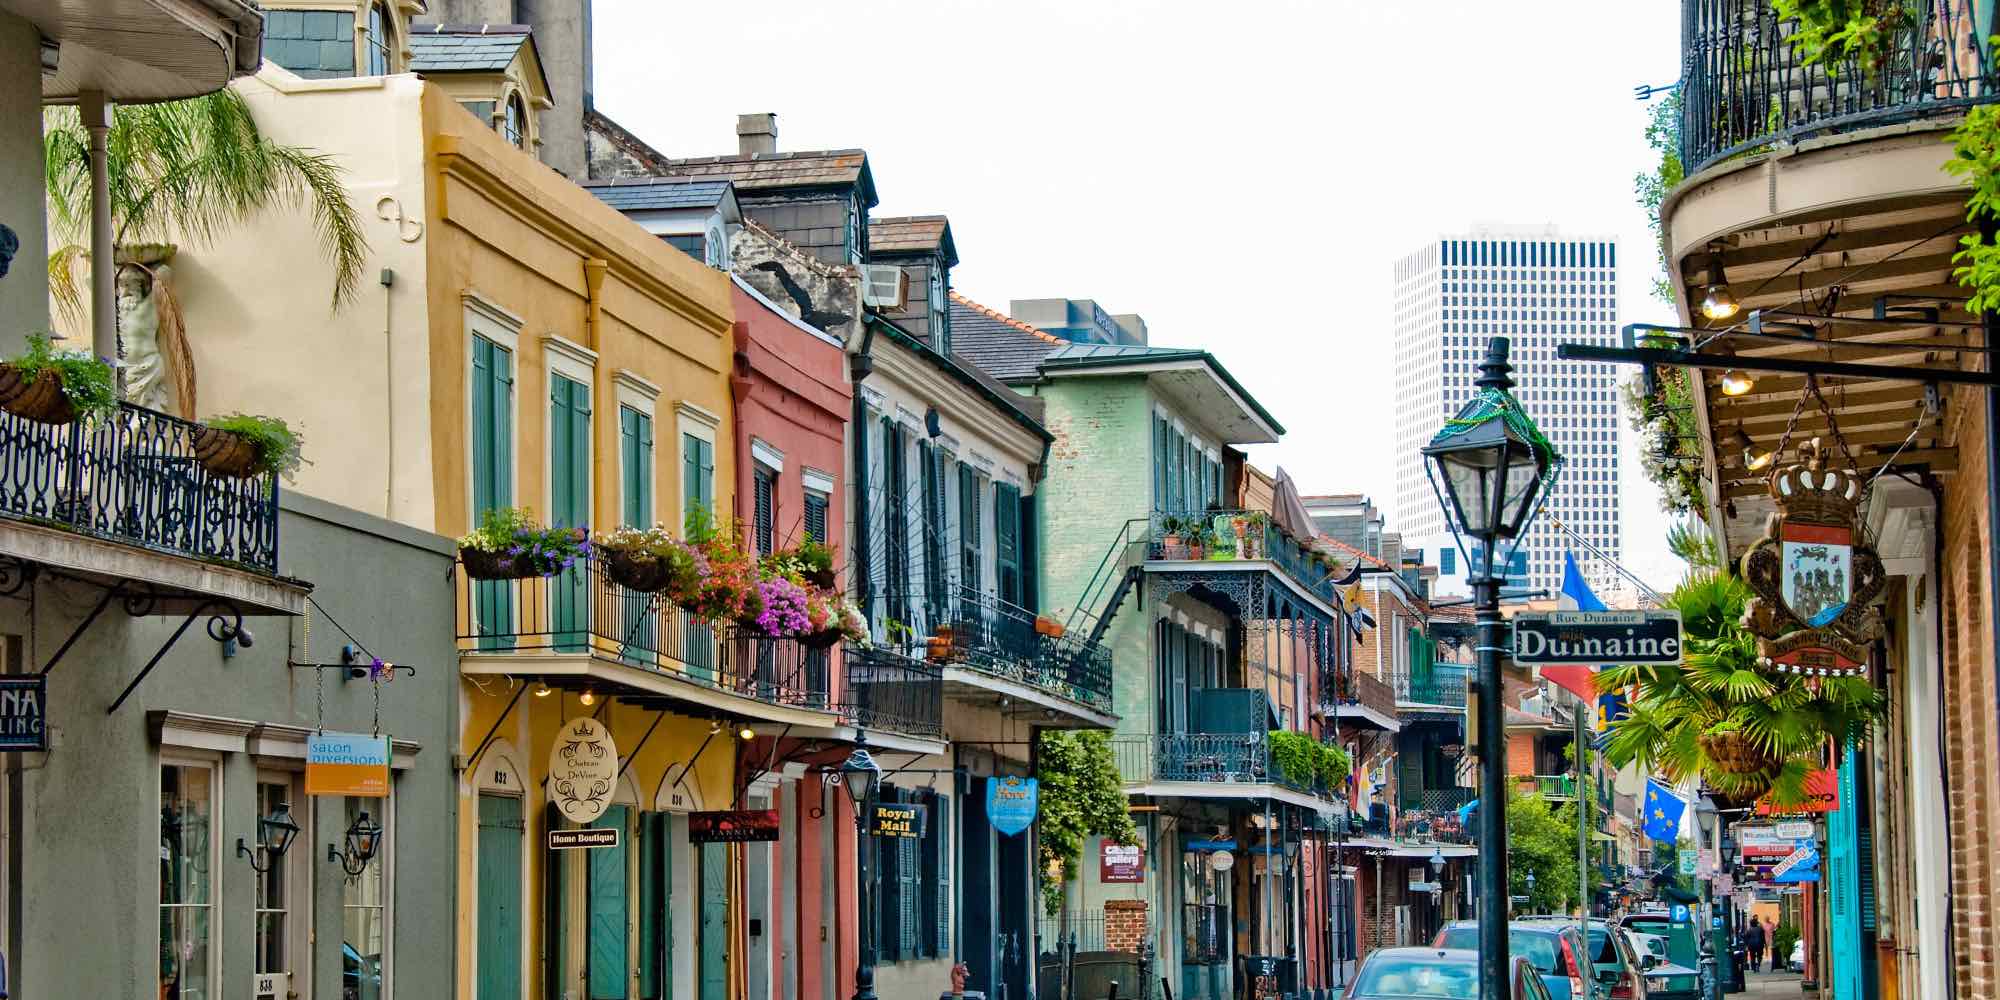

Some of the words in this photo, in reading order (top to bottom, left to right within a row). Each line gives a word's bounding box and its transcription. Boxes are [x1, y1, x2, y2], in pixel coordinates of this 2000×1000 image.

[1556, 613, 1577, 623] Rue
[1584, 613, 1636, 623] Dumaine
[1518, 628, 1678, 656] Dumaine
[495, 770, 506, 784] 832
[877, 807, 915, 820] Royal
[880, 820, 910, 831] Mail
[552, 835, 576, 844] Home
[578, 833, 615, 844] Boutique
